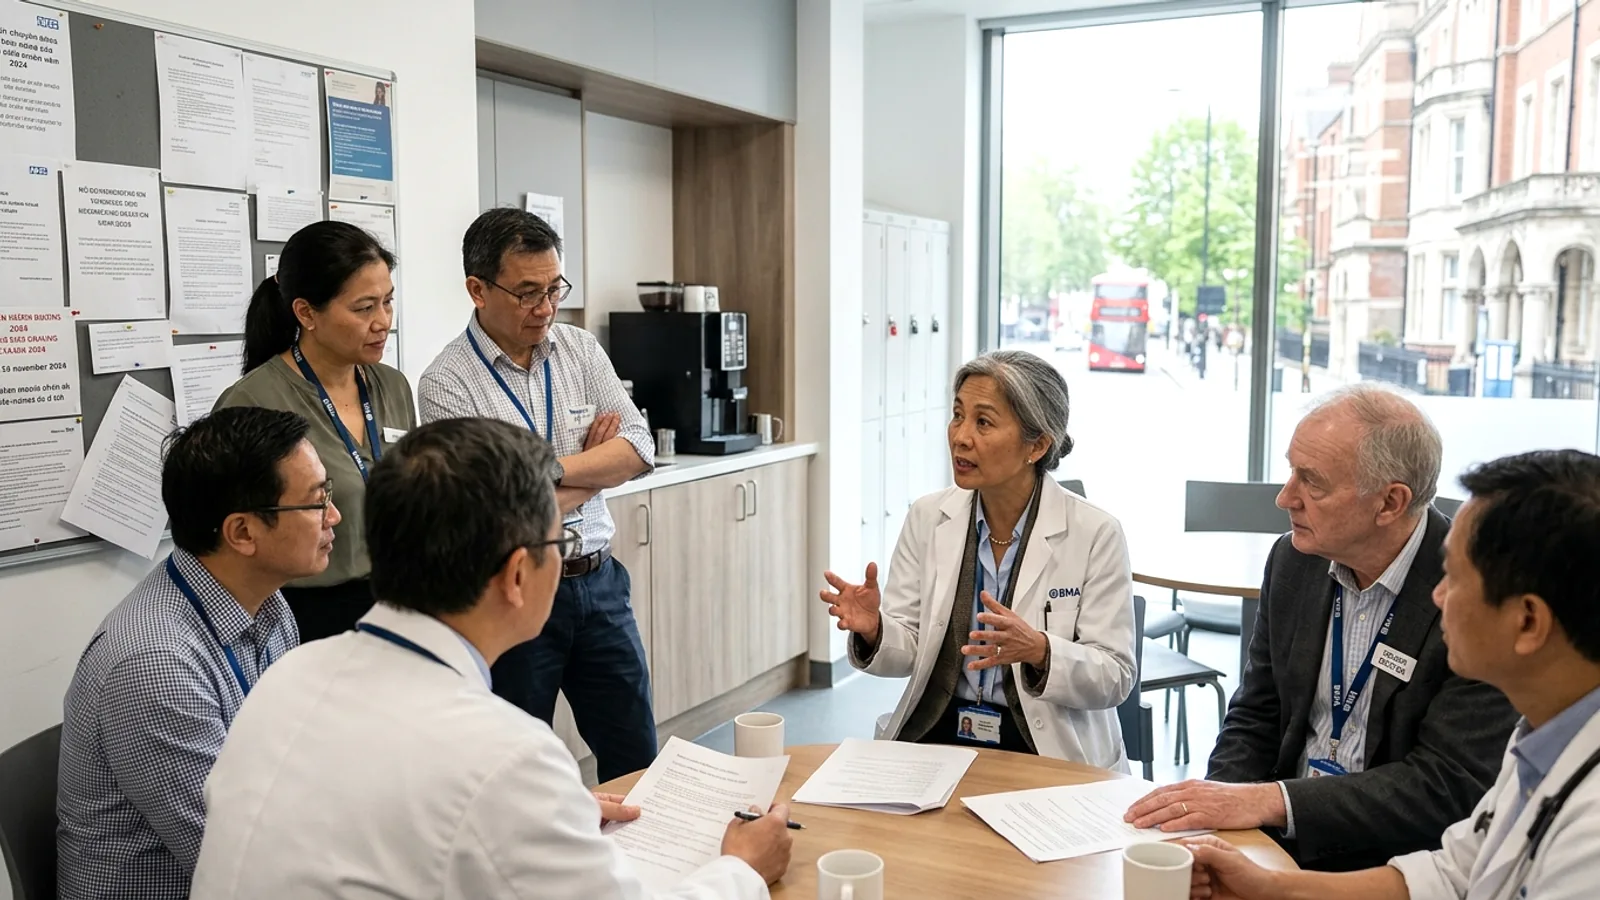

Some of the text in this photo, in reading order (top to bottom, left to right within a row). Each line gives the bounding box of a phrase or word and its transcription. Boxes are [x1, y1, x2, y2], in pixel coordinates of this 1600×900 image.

[10, 60, 28, 68] 2024
[12, 364, 47, 372] november
[1059, 588, 1080, 598] BMA
